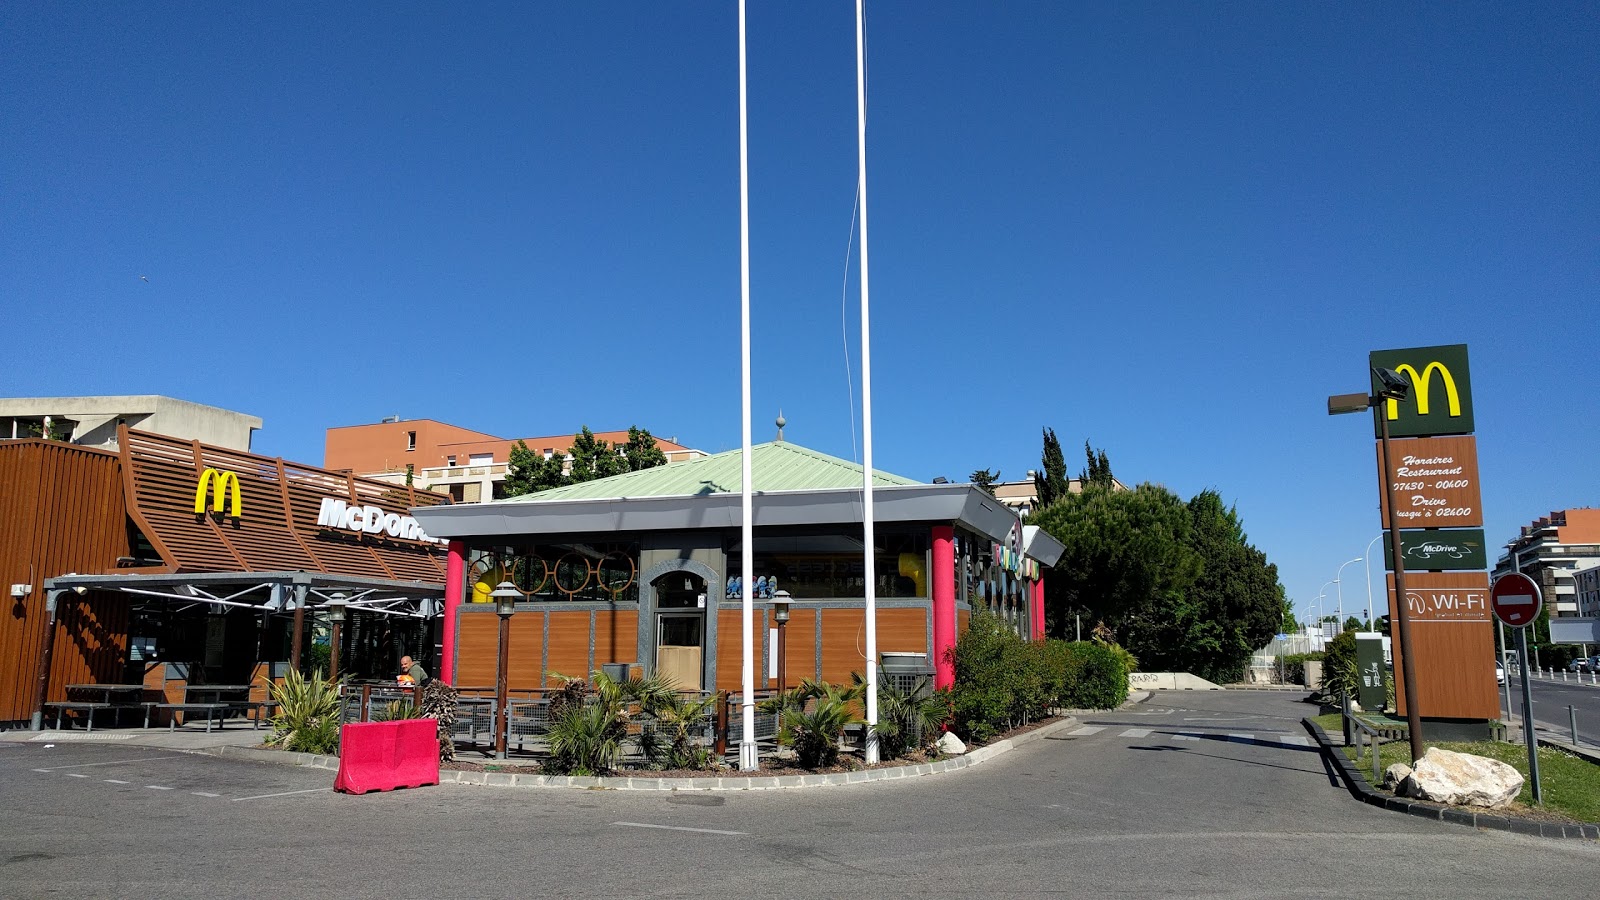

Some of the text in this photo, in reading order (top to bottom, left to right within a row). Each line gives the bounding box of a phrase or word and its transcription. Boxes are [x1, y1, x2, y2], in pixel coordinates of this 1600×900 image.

[1402, 455, 1454, 466] Horaires
[1396, 466, 1463, 478] Restaurant
[1435, 479, 1469, 489] 00h00
[1411, 494, 1447, 506] Drive
[1435, 507, 1471, 517] 02h00
[1422, 544, 1458, 552] McDrive
[1432, 594, 1485, 609] Wi-Fi
